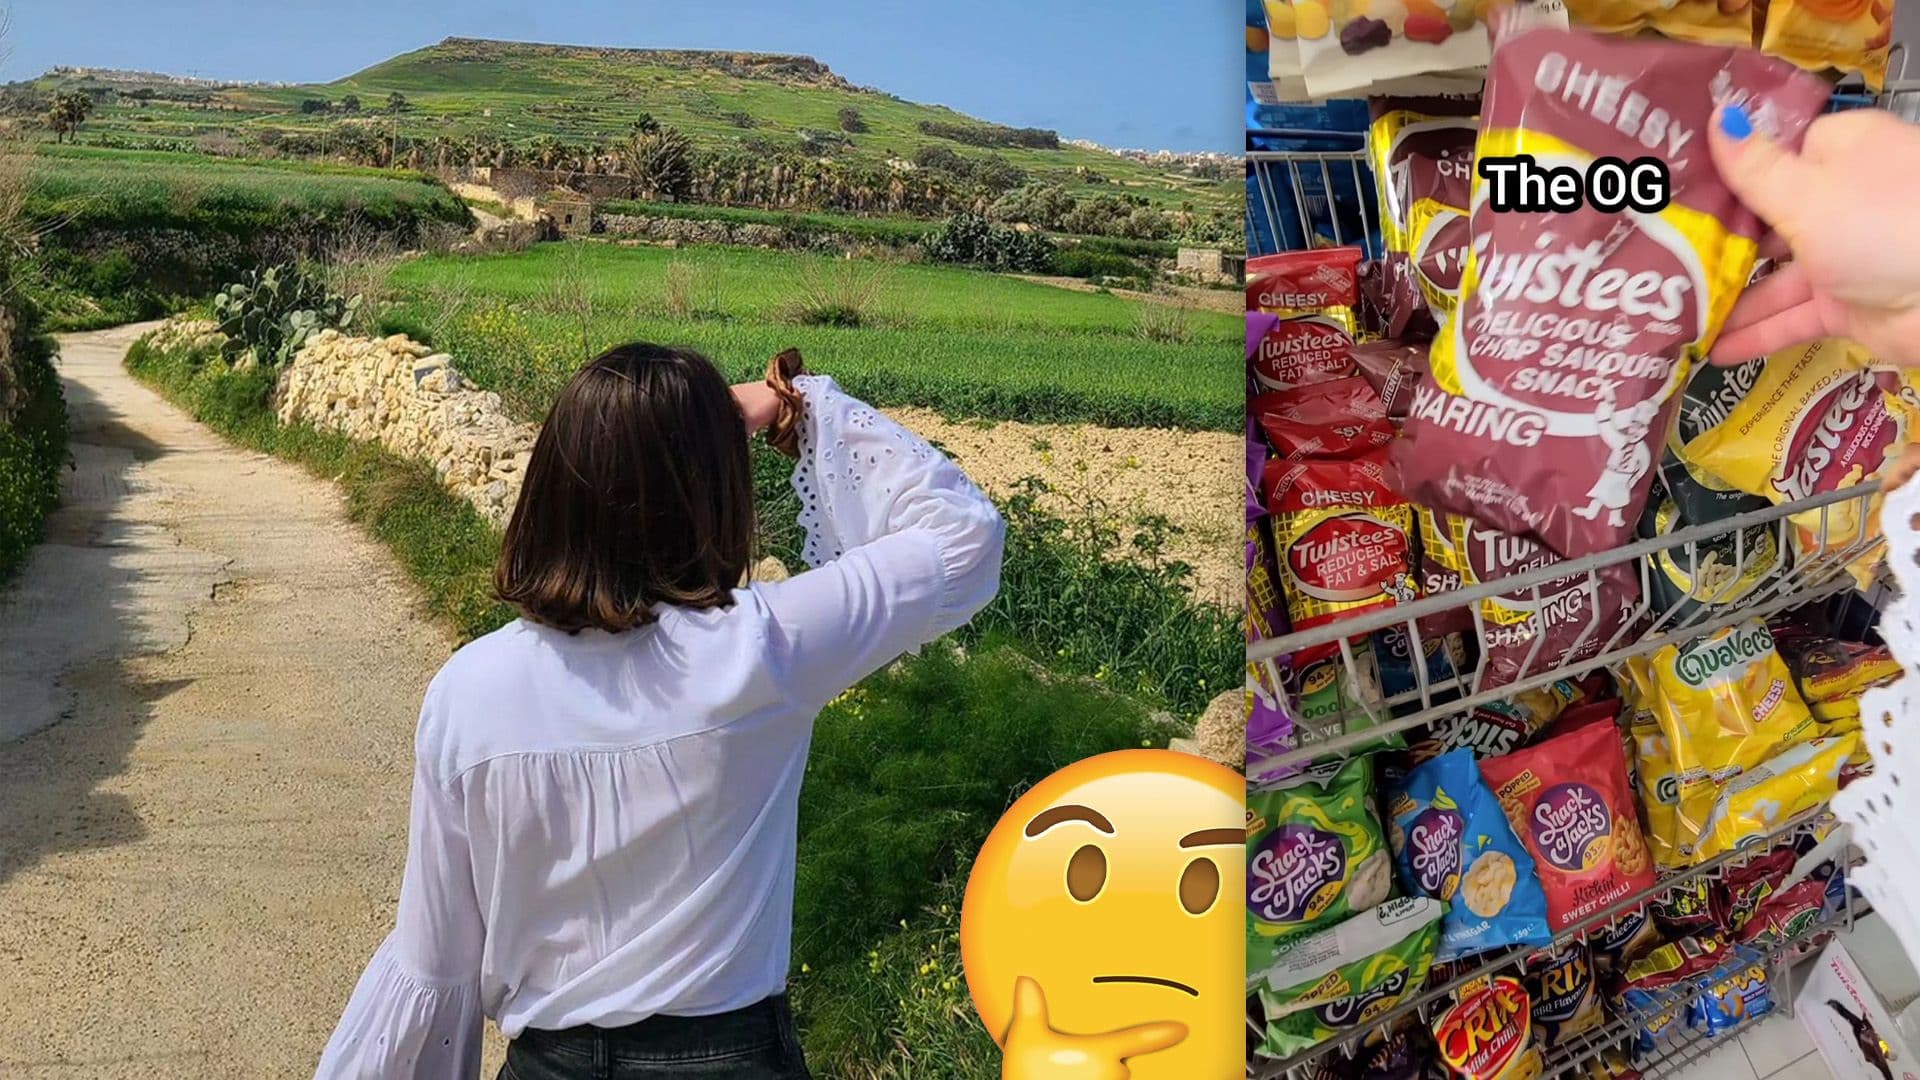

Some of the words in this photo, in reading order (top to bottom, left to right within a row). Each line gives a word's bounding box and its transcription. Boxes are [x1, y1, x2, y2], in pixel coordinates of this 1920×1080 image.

[1534, 52, 1694, 159] CHEESY
[1259, 292, 1328, 307] CHEESY
[1259, 331, 1344, 361] Twistees
[1271, 350, 1331, 370] REDUCED
[1279, 367, 1302, 381] FAT
[1318, 357, 1348, 372] SALT
[1740, 387, 1785, 435] EXPERIENCE
[1781, 367, 1800, 390] THE
[1795, 343, 1822, 371] TASTE
[1771, 368, 1876, 501] Tastees
[1773, 406, 1803, 453] ORIGINAL
[1799, 375, 1832, 406] BAKED
[1301, 490, 1375, 506] CHEESY
[1293, 528, 1394, 568] Twistees
[1316, 545, 1384, 577] REDUCED
[1325, 568, 1353, 588] FAT
[1357, 564, 1368, 577] &
[1370, 552, 1402, 572] SALT
[1307, 673, 1325, 685] 94
[1752, 679, 1785, 722] CHEESE
[1499, 771, 1531, 799] POPPED
[1536, 787, 1592, 845] Snack
[1412, 815, 1458, 869] Snack
[1250, 832, 1327, 903] Snack
[1562, 899, 1597, 923] SWEET
[1600, 881, 1631, 906] CHILLI
[1542, 958, 1588, 1001] RIX
[1364, 1003, 1380, 1017] 94
[1440, 989, 1519, 1067] CRIX
[1464, 1050, 1489, 1075] Mild
[1490, 1021, 1518, 1052] Chilli
